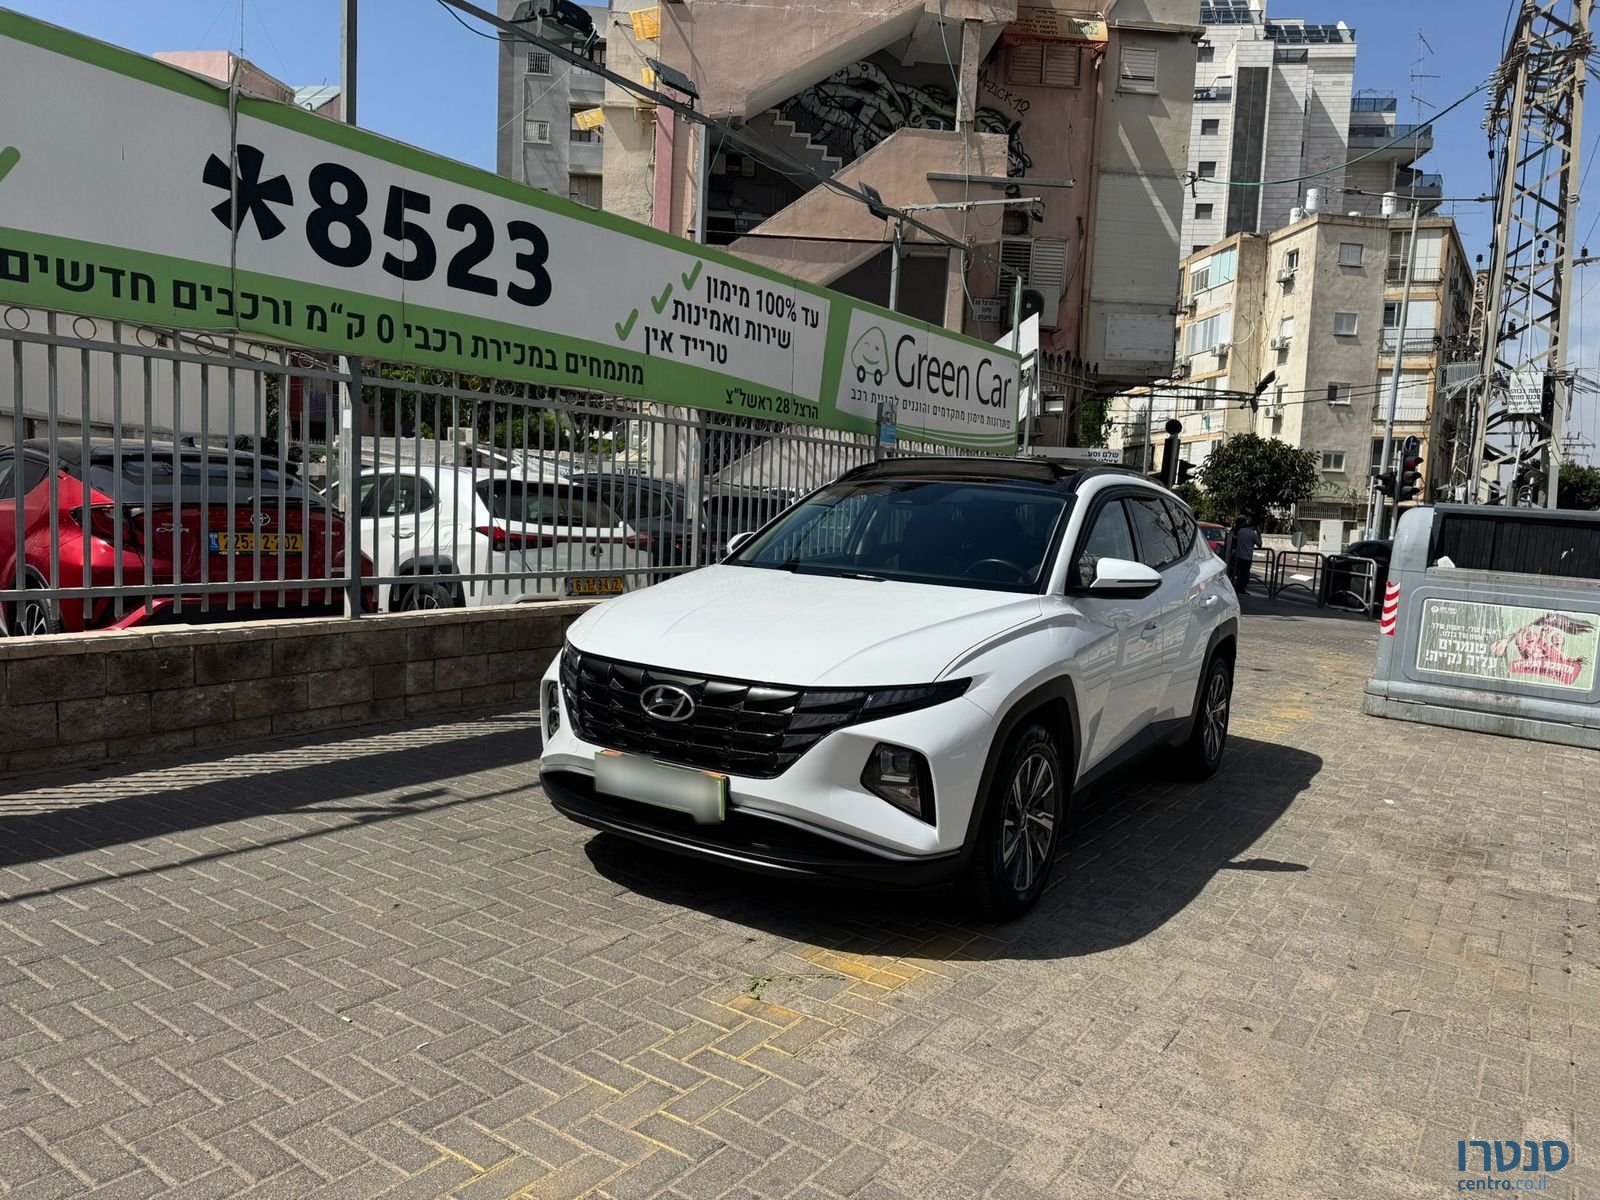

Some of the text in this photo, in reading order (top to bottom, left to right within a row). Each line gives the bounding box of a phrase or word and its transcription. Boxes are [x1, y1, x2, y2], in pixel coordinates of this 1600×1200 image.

[705, 274, 820, 330] עד 100% מימון
[0, 248, 645, 386] מתמחים במכירת רכבי 0 ק"מ ורכבים חדשים
[672, 299, 791, 350] שירות ואמינות
[644, 325, 729, 366] טרייד אין
[895, 334, 1012, 409] Green Car
[725, 386, 820, 420] הרצל 28 ראשל"צ
[851, 387, 867, 402] רכב
[902, 399, 930, 414] והוגנים
[932, 405, 965, 422] מתקדמים
[967, 411, 985, 425] מימון
[986, 415, 1011, 430] פתרונות
[1438, 638, 1487, 654] שומרים
[1425, 650, 1498, 669] עליה נקייה!
